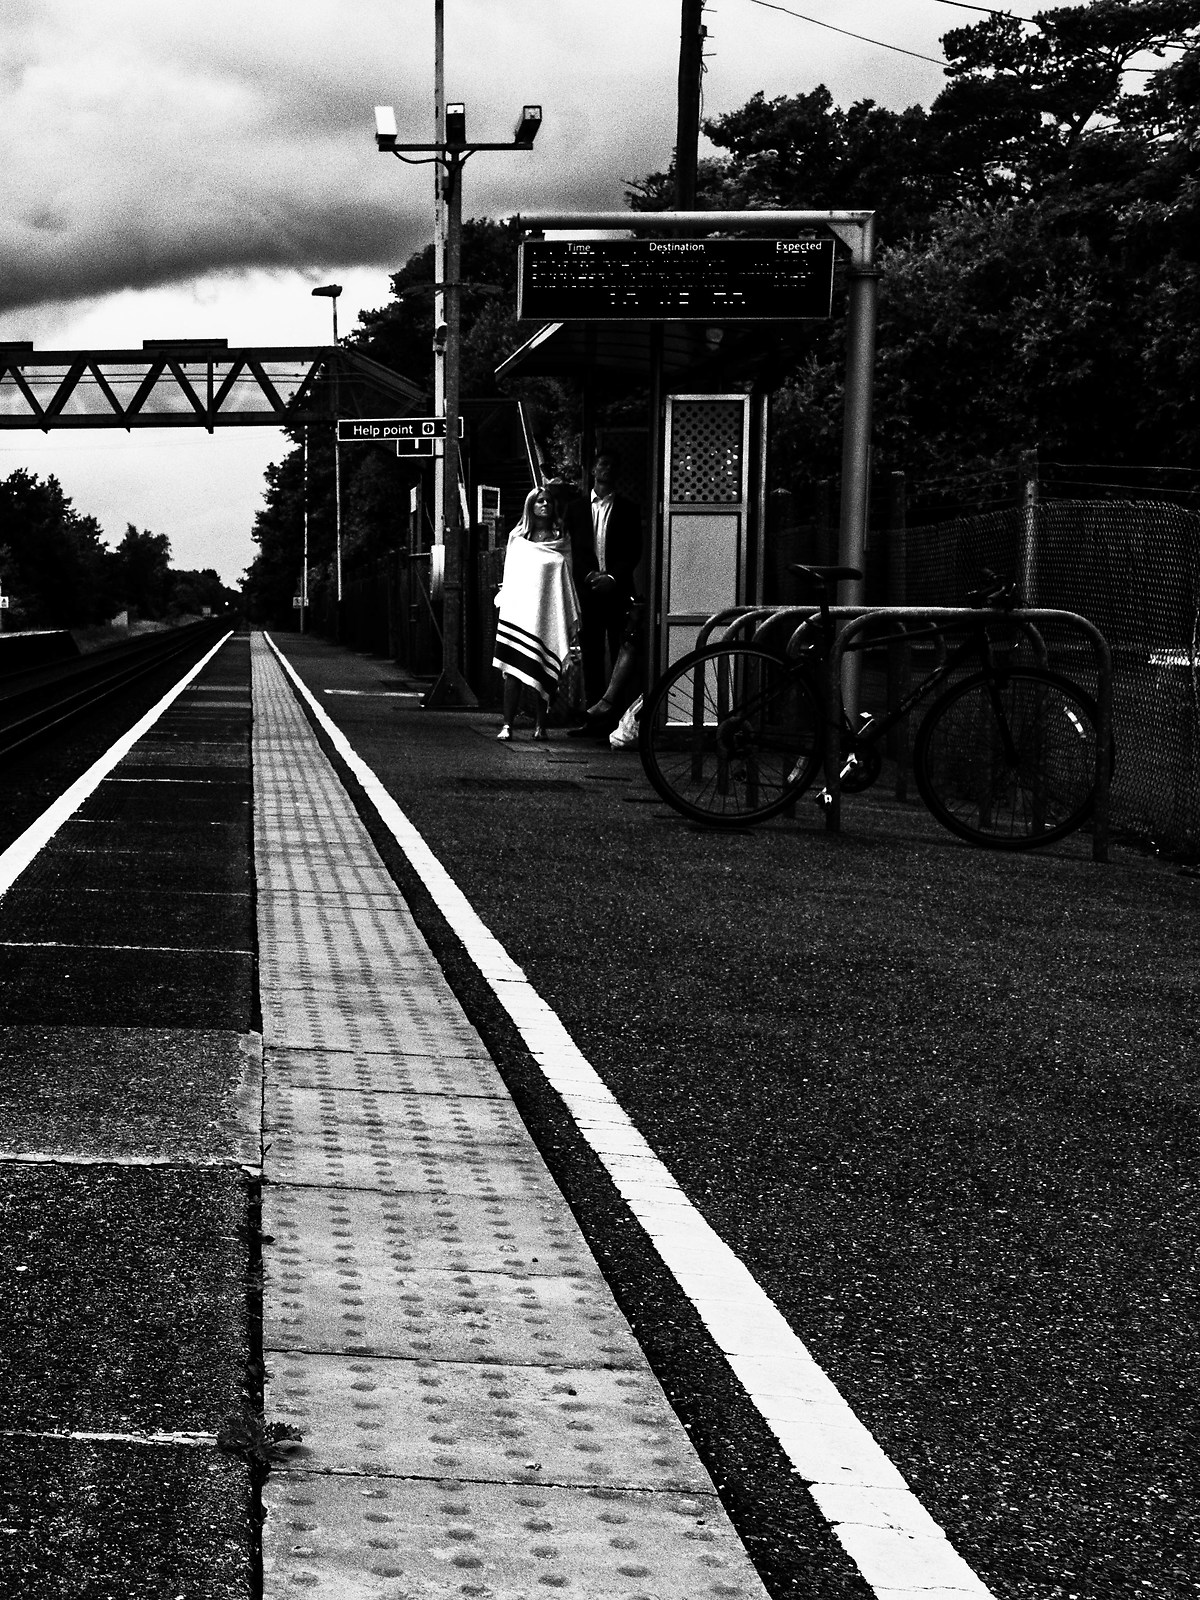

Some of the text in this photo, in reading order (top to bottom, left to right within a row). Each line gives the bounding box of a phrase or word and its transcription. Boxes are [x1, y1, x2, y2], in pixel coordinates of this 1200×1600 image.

[567, 242, 591, 252] Time
[649, 242, 705, 251] Destination
[776, 241, 822, 251] Expected
[353, 424, 413, 437] Help point
